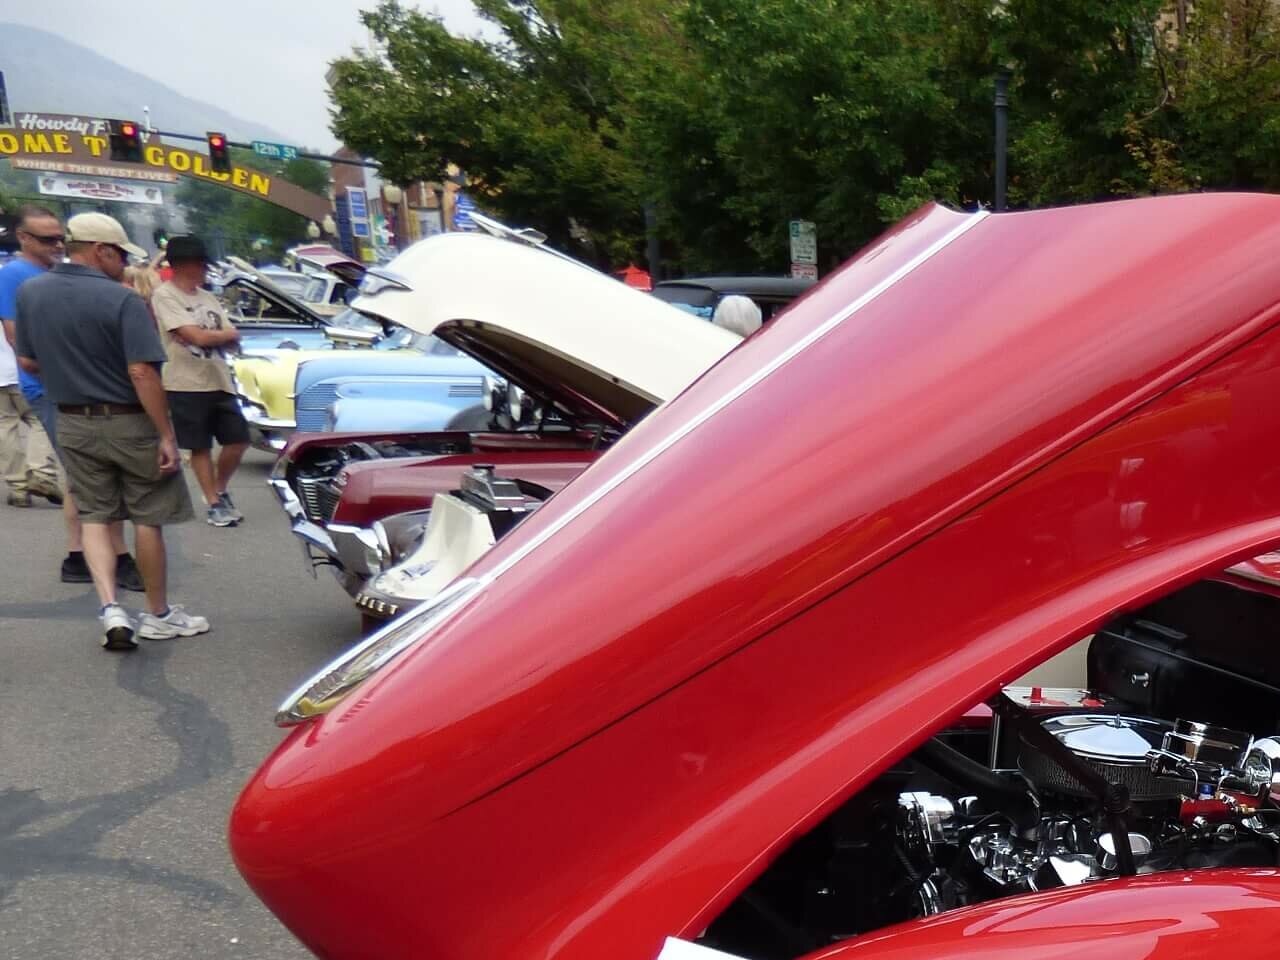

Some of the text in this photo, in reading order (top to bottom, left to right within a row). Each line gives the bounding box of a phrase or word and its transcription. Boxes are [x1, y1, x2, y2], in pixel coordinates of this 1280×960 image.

[20, 113, 89, 136] Howdy
[16, 159, 65, 171] WHERE
[68, 163, 94, 174] THE
[96, 165, 133, 178] WEST
[83, 136, 106, 157] T
[144, 145, 270, 196] GOLEN
